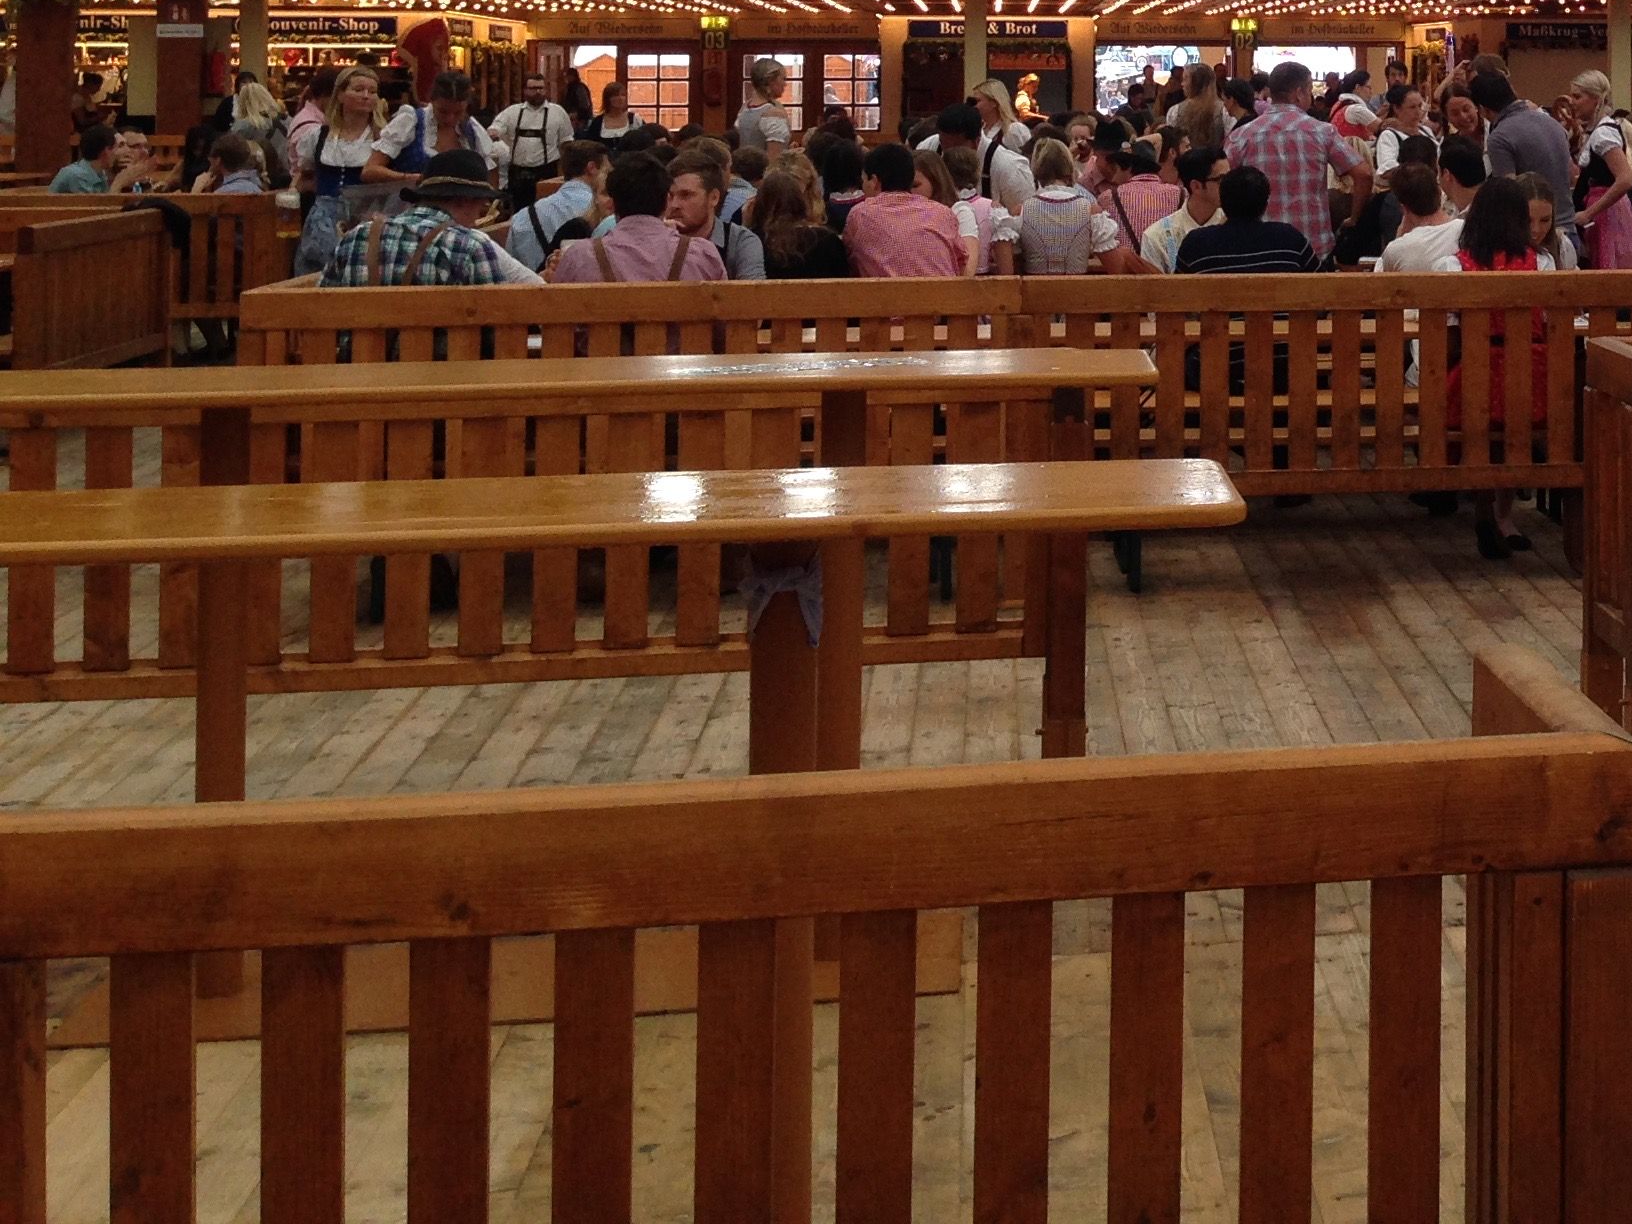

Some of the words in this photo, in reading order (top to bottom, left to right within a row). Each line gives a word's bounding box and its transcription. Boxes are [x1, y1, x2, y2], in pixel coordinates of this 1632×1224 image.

[269, 17, 380, 35] ouvenir-Shop
[987, 22, 1000, 34] &
[1005, 22, 1038, 34] Brot
[705, 31, 725, 49] 03
[1234, 32, 1255, 50] 02
